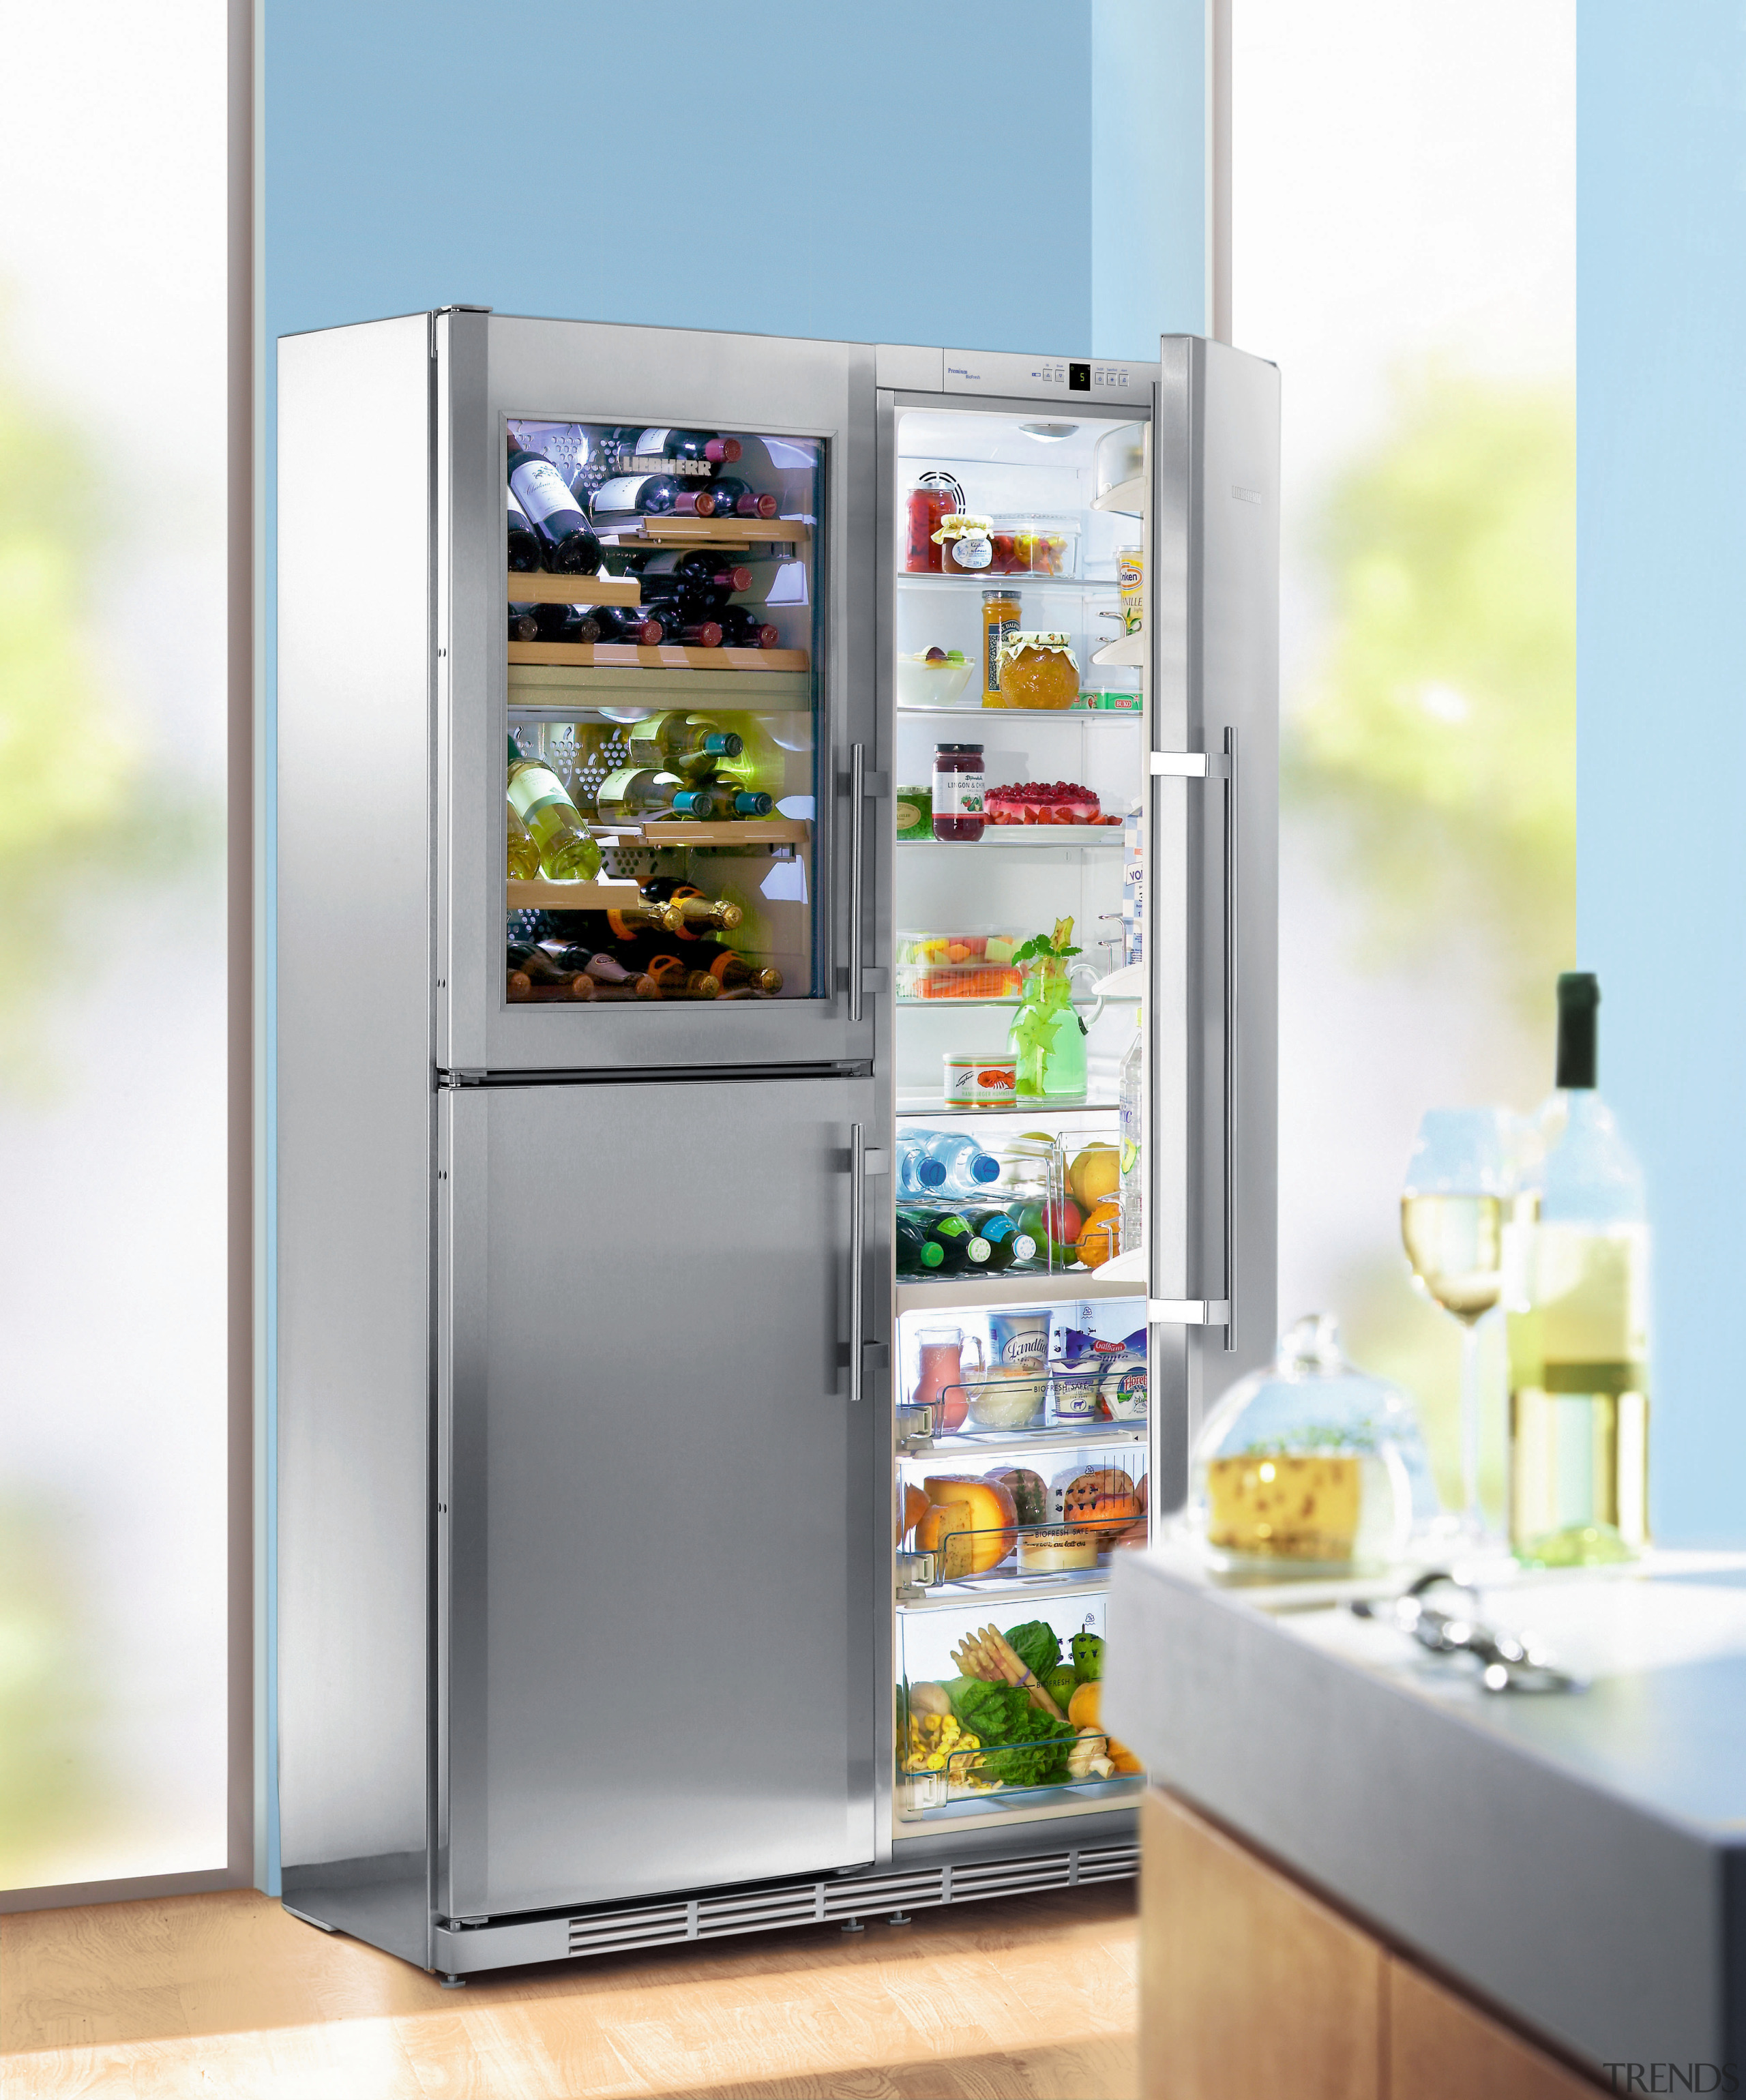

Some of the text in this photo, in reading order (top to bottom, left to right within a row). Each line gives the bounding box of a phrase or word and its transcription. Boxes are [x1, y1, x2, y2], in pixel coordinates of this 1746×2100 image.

[1080, 372, 1085, 382] 5
[623, 456, 712, 476] LIEBHERR
[1095, 1340, 1123, 1352] Galbani
[1034, 1384, 1067, 1393] BIOFRESH
[1071, 1382, 1088, 1391] SAFE
[1035, 1530, 1069, 1538] BIOFRESH
[1037, 1676, 1090, 1689] BIOFRESH SAFE
